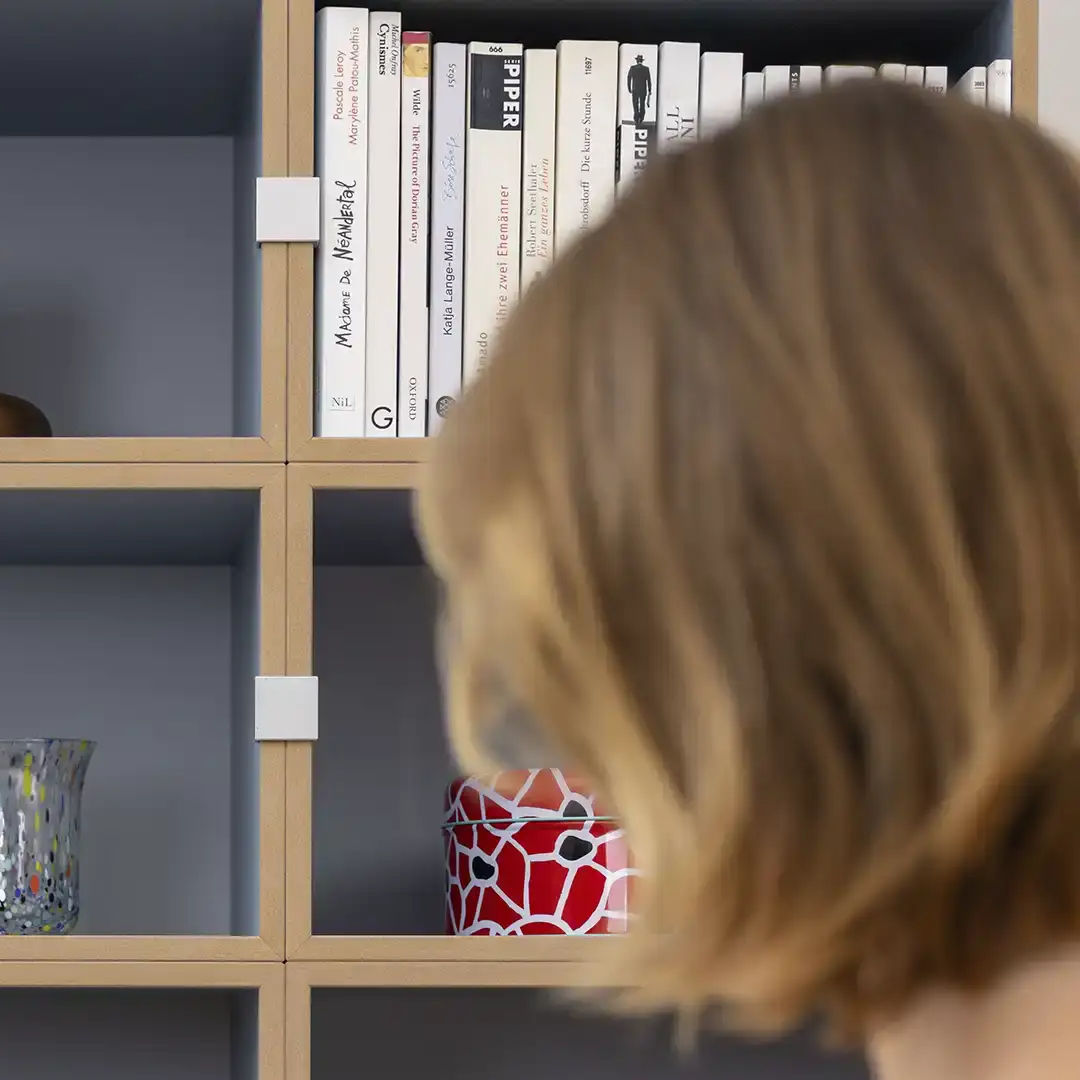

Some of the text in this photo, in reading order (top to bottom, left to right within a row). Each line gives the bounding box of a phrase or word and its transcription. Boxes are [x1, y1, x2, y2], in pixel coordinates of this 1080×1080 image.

[377, 23, 390, 76] Cynismes
[389, 24, 400, 76] Michel Onfray
[446, 63, 456, 88] 15625
[332, 50, 346, 120] Pascale Leroy
[348, 27, 361, 145] Marylène Patou-Mathis
[410, 89, 421, 115] Wilde
[503, 63, 520, 128] PIPER
[581, 92, 592, 125] Stunde
[581, 128, 591, 153] kurze
[581, 155, 591, 173] Die
[409, 125, 421, 244] The Picture of Dorian Gray
[526, 163, 538, 257] Robert Seethaler
[538, 158, 551, 259] Ein ganzes Leben
[495, 185, 510, 257] Ehemänner
[442, 226, 457, 336] Katja Lange-Müller
[496, 262, 509, 290] zwei
[496, 295, 508, 320] ihre
[371, 406, 393, 429] G
[408, 377, 418, 420] OXFORD
